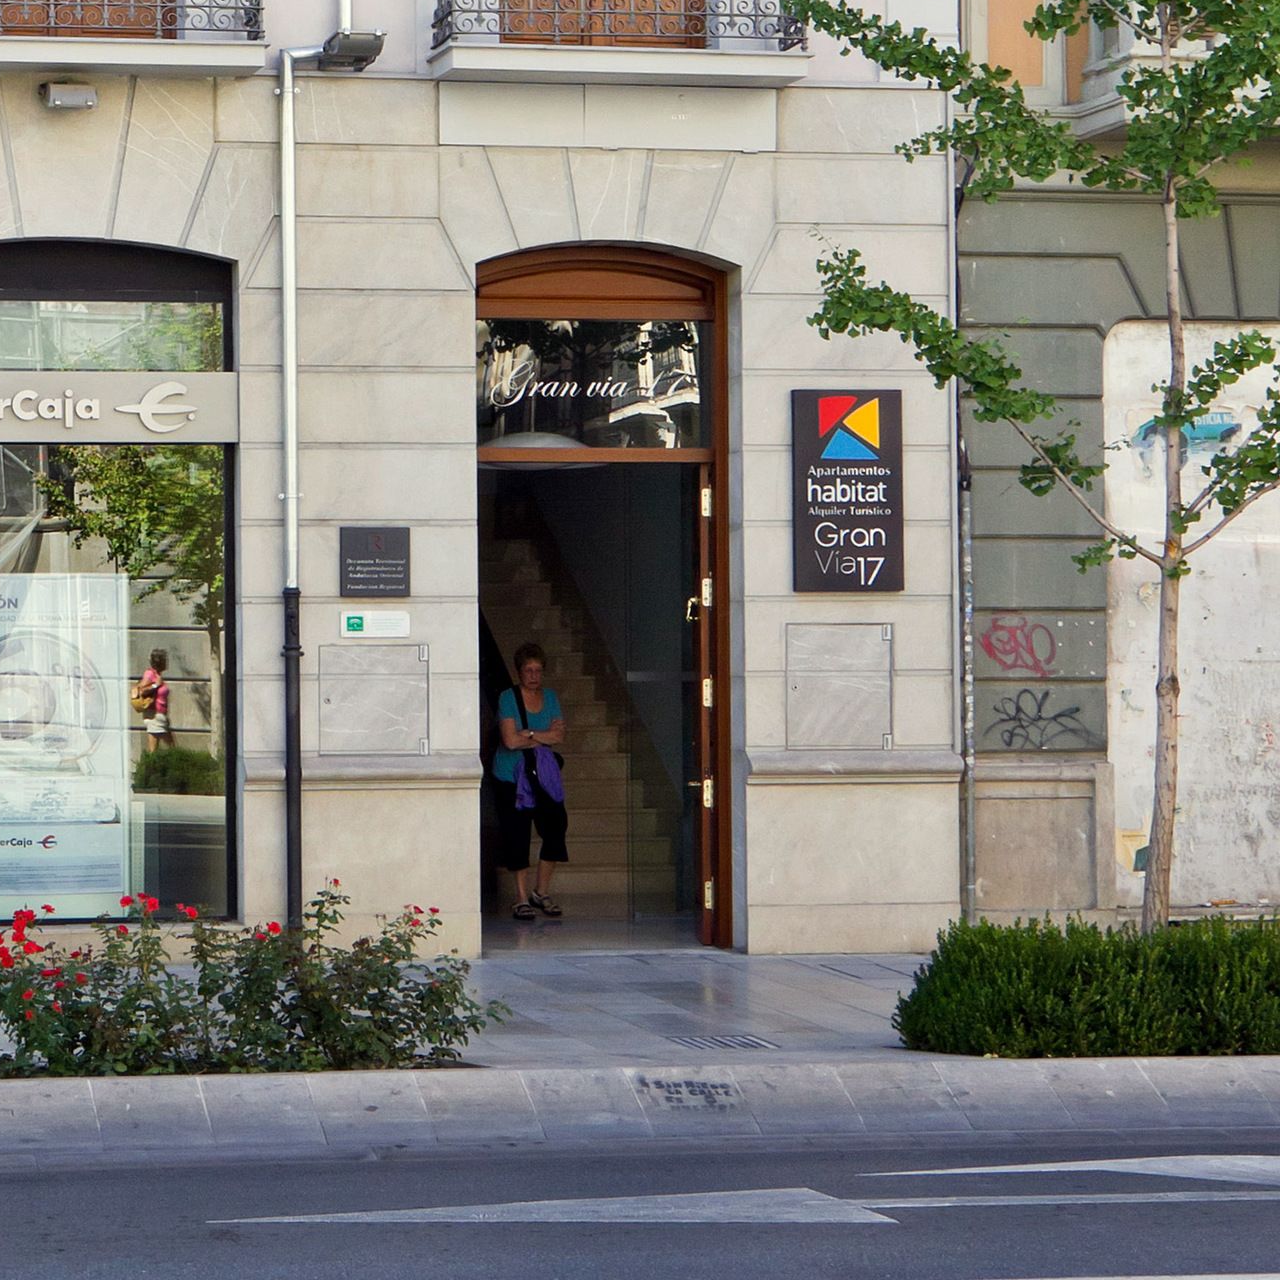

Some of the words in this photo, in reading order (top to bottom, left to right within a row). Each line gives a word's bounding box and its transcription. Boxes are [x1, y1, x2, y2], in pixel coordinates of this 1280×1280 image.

[491, 358, 583, 407] Gran
[586, 376, 630, 398] via
[807, 465, 892, 478] Apartamentos
[807, 478, 888, 502] habitat
[808, 505, 847, 518] Alquiler
[814, 522, 886, 547] Gran
